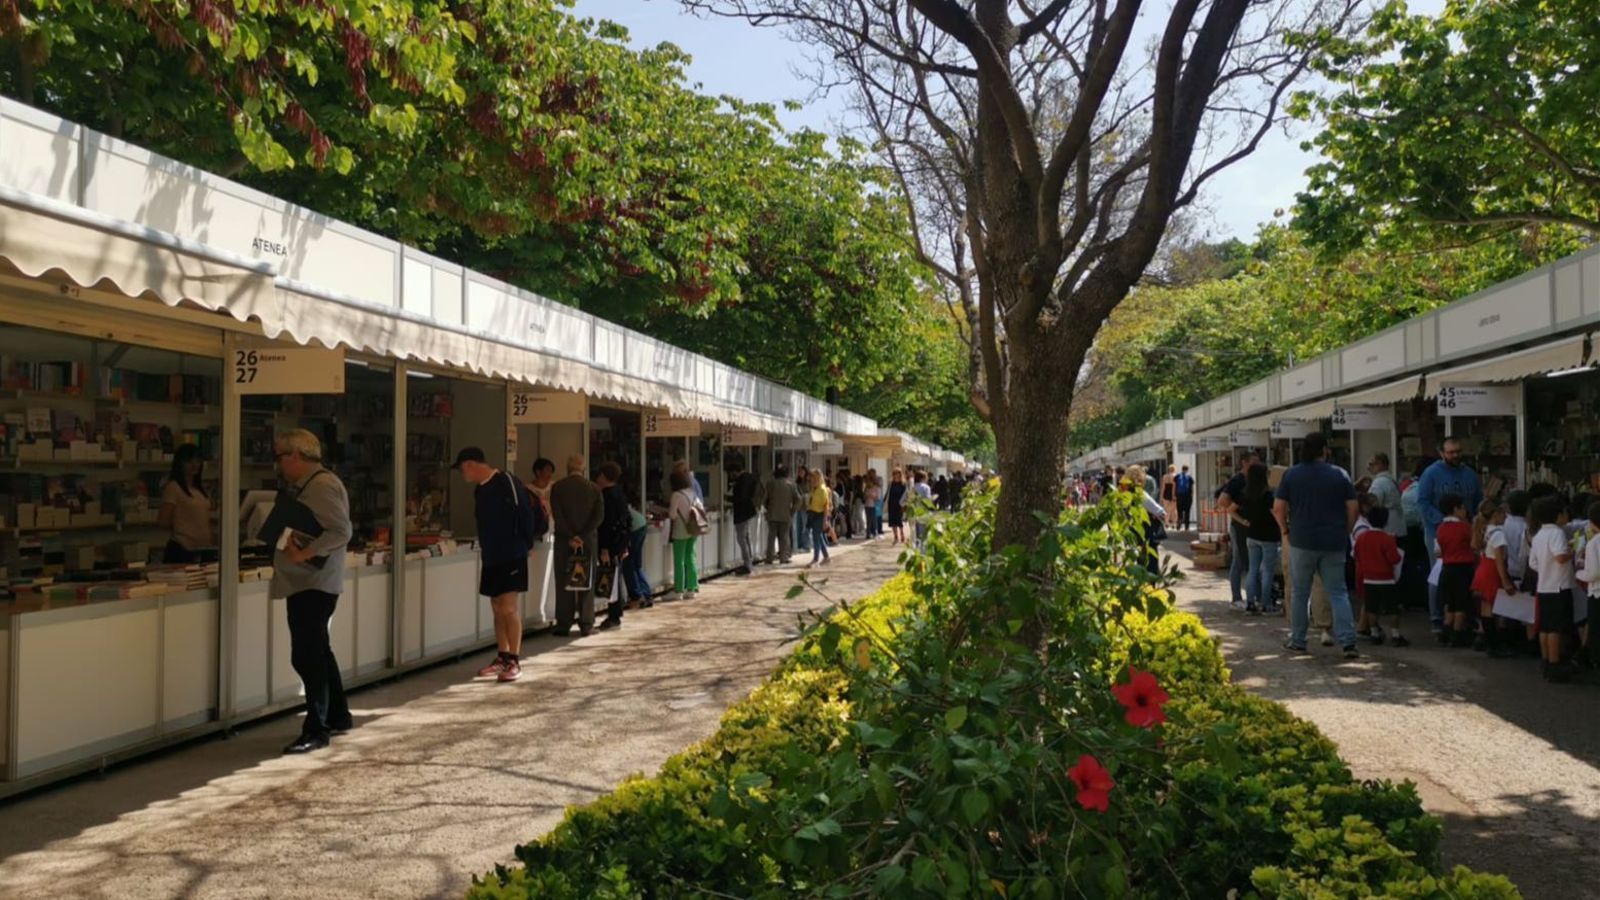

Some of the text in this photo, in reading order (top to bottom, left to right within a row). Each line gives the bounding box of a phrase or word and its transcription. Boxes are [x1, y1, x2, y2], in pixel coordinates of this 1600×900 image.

[252, 237, 288, 257] ATENEA
[236, 350, 286, 366] 26 Atenea
[236, 367, 258, 383] 27
[1439, 387, 1455, 397] 45
[513, 394, 528, 404] 26
[1439, 398, 1456, 409] 46
[513, 405, 528, 416] 27
[1333, 408, 1345, 417] 45
[646, 415, 656, 423] 24
[1333, 417, 1346, 425] 46
[646, 424, 656, 432] 25
